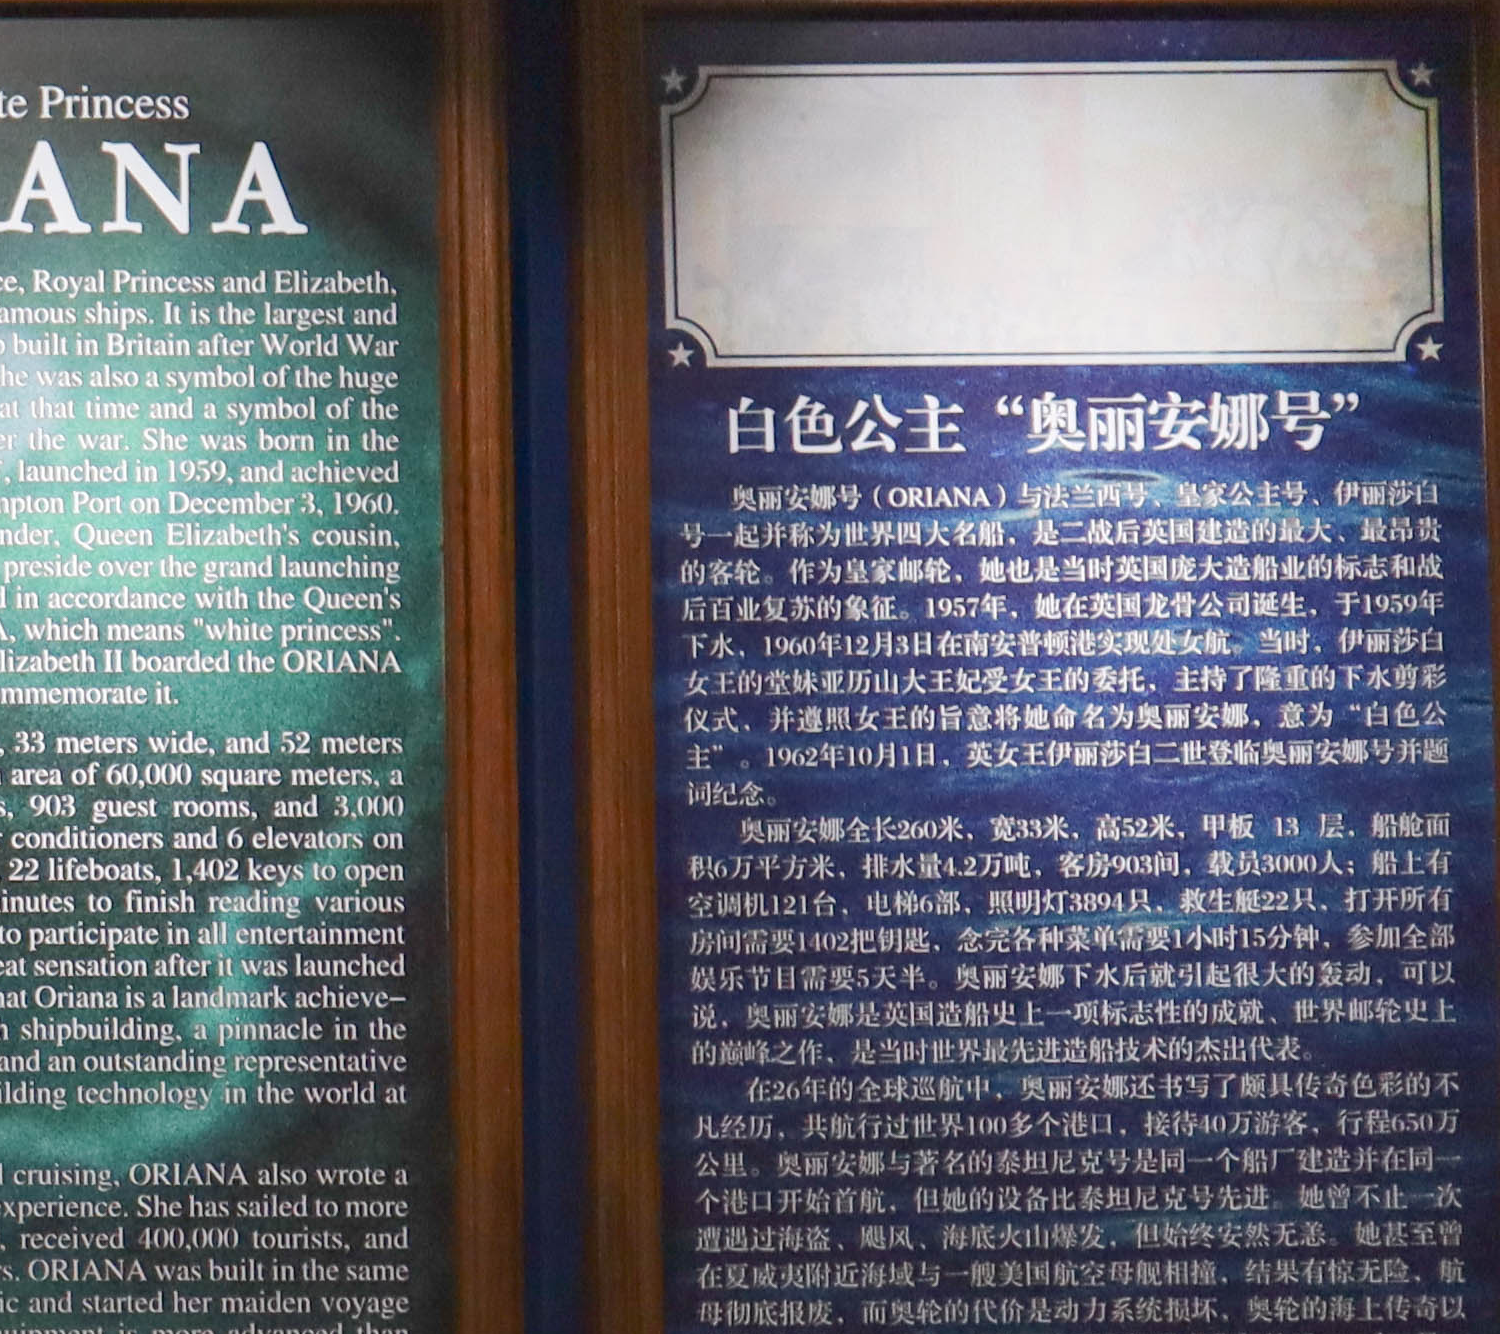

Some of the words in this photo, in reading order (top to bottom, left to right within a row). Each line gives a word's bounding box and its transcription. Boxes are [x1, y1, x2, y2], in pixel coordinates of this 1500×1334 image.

[39, 88, 190, 120] Princess
[32, 268, 105, 298] Royal
[113, 269, 216, 294] Princess
[221, 269, 267, 294] and
[274, 269, 397, 297] Elizabeth,
[24, 616, 99, 642] which
[106, 623, 185, 642] means
[193, 616, 274, 642] "white
[280, 612, 401, 646] princess".
[13, 729, 46, 754] 33
[55, 734, 139, 755] meters
[147, 729, 216, 757] wide,
[225, 730, 270, 755] and
[280, 730, 311, 755] 52
[321, 734, 404, 755] meters
[28, 793, 76, 818] 903
[91, 797, 158, 823] guest
[172, 789, 258, 822] rooms,
[272, 793, 319, 818] and
[333, 794, 405, 820] 3,000
[687, 777, 778, 808] 词纪念。
